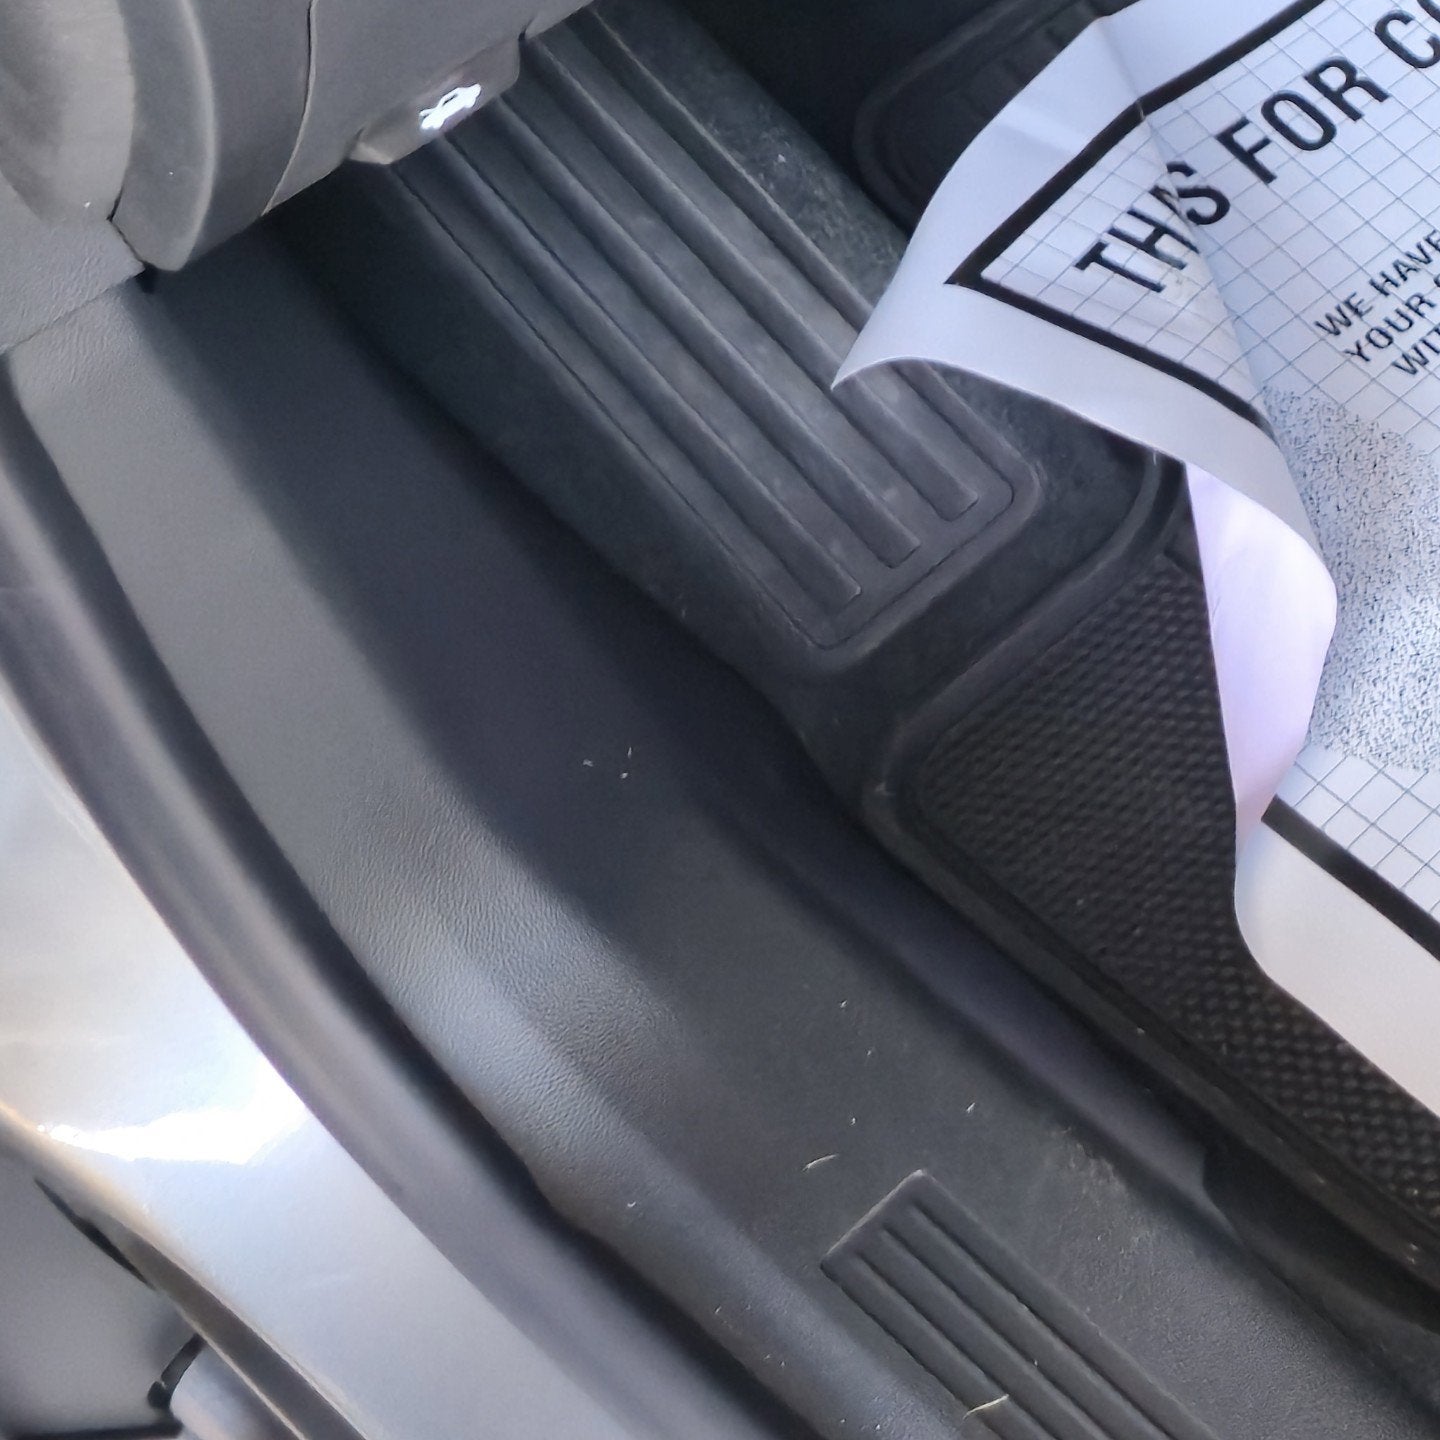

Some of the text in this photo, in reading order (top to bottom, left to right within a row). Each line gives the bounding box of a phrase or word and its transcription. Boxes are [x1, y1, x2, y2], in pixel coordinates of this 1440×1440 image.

[1214, 55, 1390, 189] FOR
[1316, 292, 1374, 342] WE
[1347, 288, 1436, 367] YOUR
